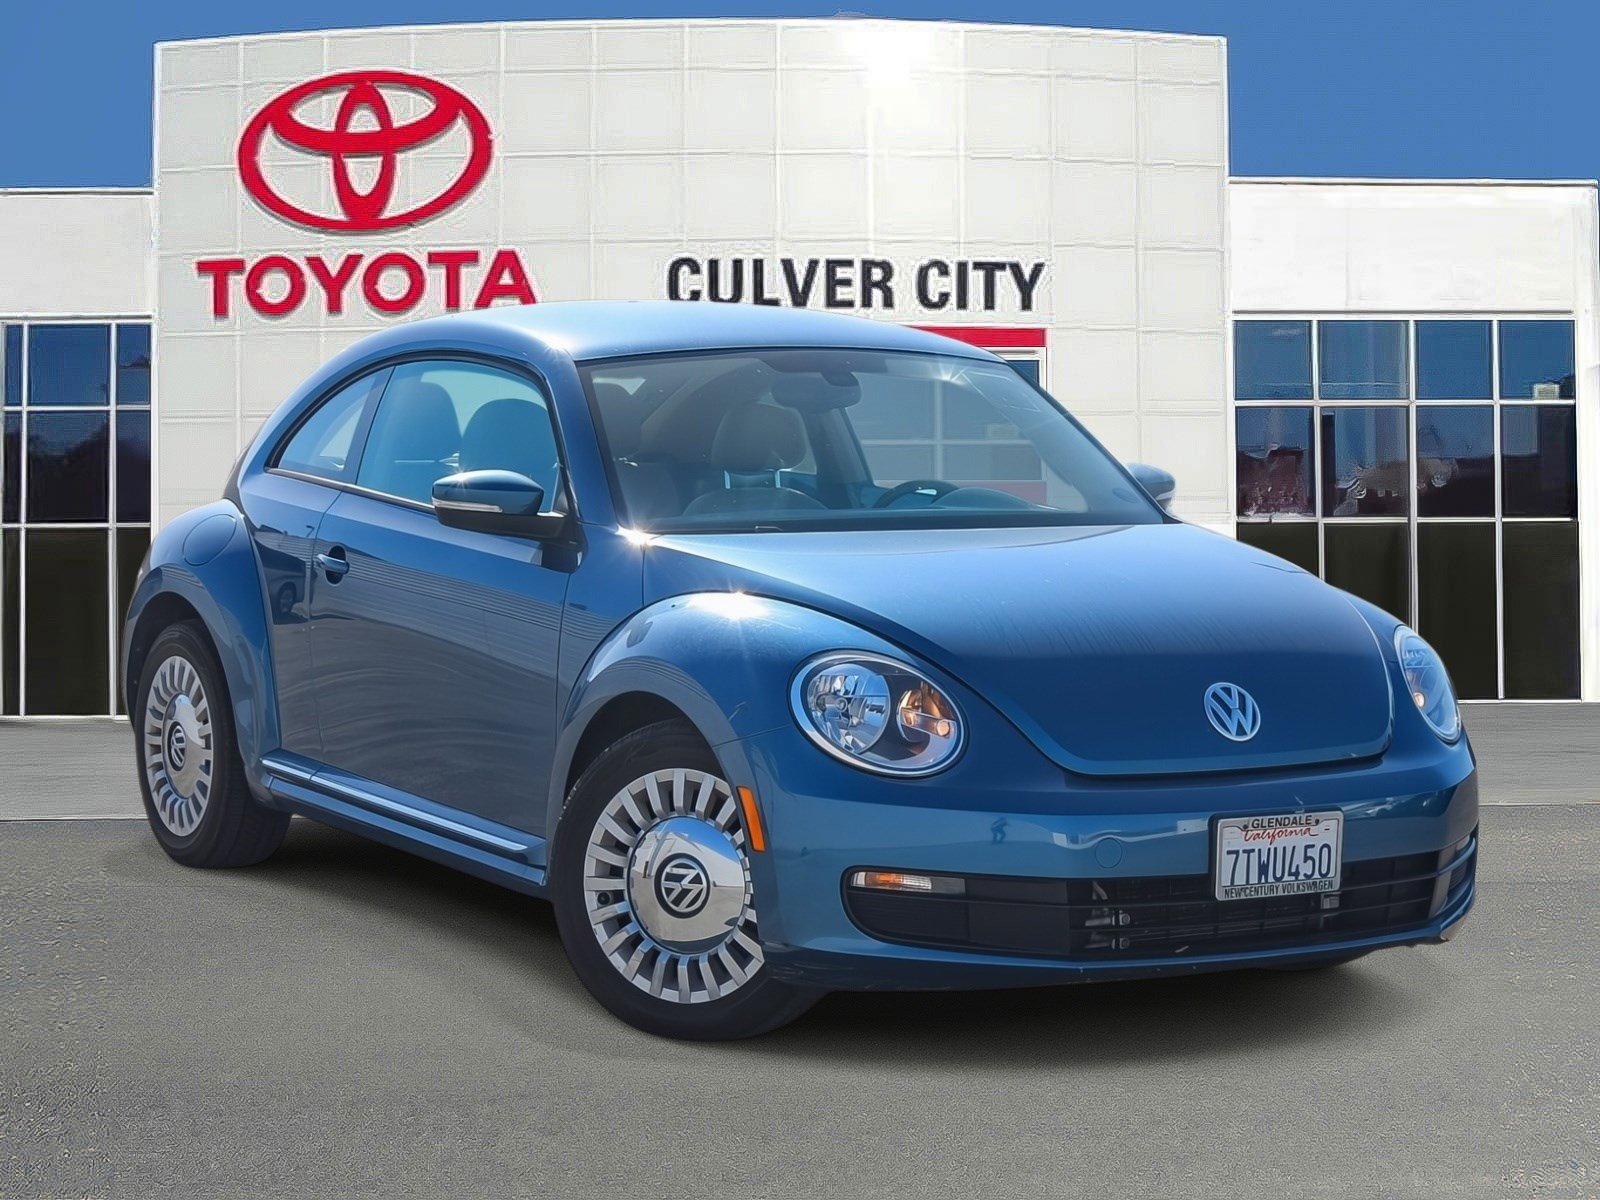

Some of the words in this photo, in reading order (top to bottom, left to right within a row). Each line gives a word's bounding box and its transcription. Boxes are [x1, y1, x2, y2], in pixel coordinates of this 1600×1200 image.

[196, 249, 537, 319] TOYOTA
[668, 257, 895, 309] CULVER
[915, 259, 1046, 311] CITY
[1243, 827, 1320, 845] California
[1251, 815, 1313, 829] GLENDALE
[1226, 843, 1332, 887] 7TWU450
[1224, 886, 1241, 899] NEW
[1244, 882, 1279, 897] CENTURY
[1281, 879, 1333, 893] VOLKSWAGEN
